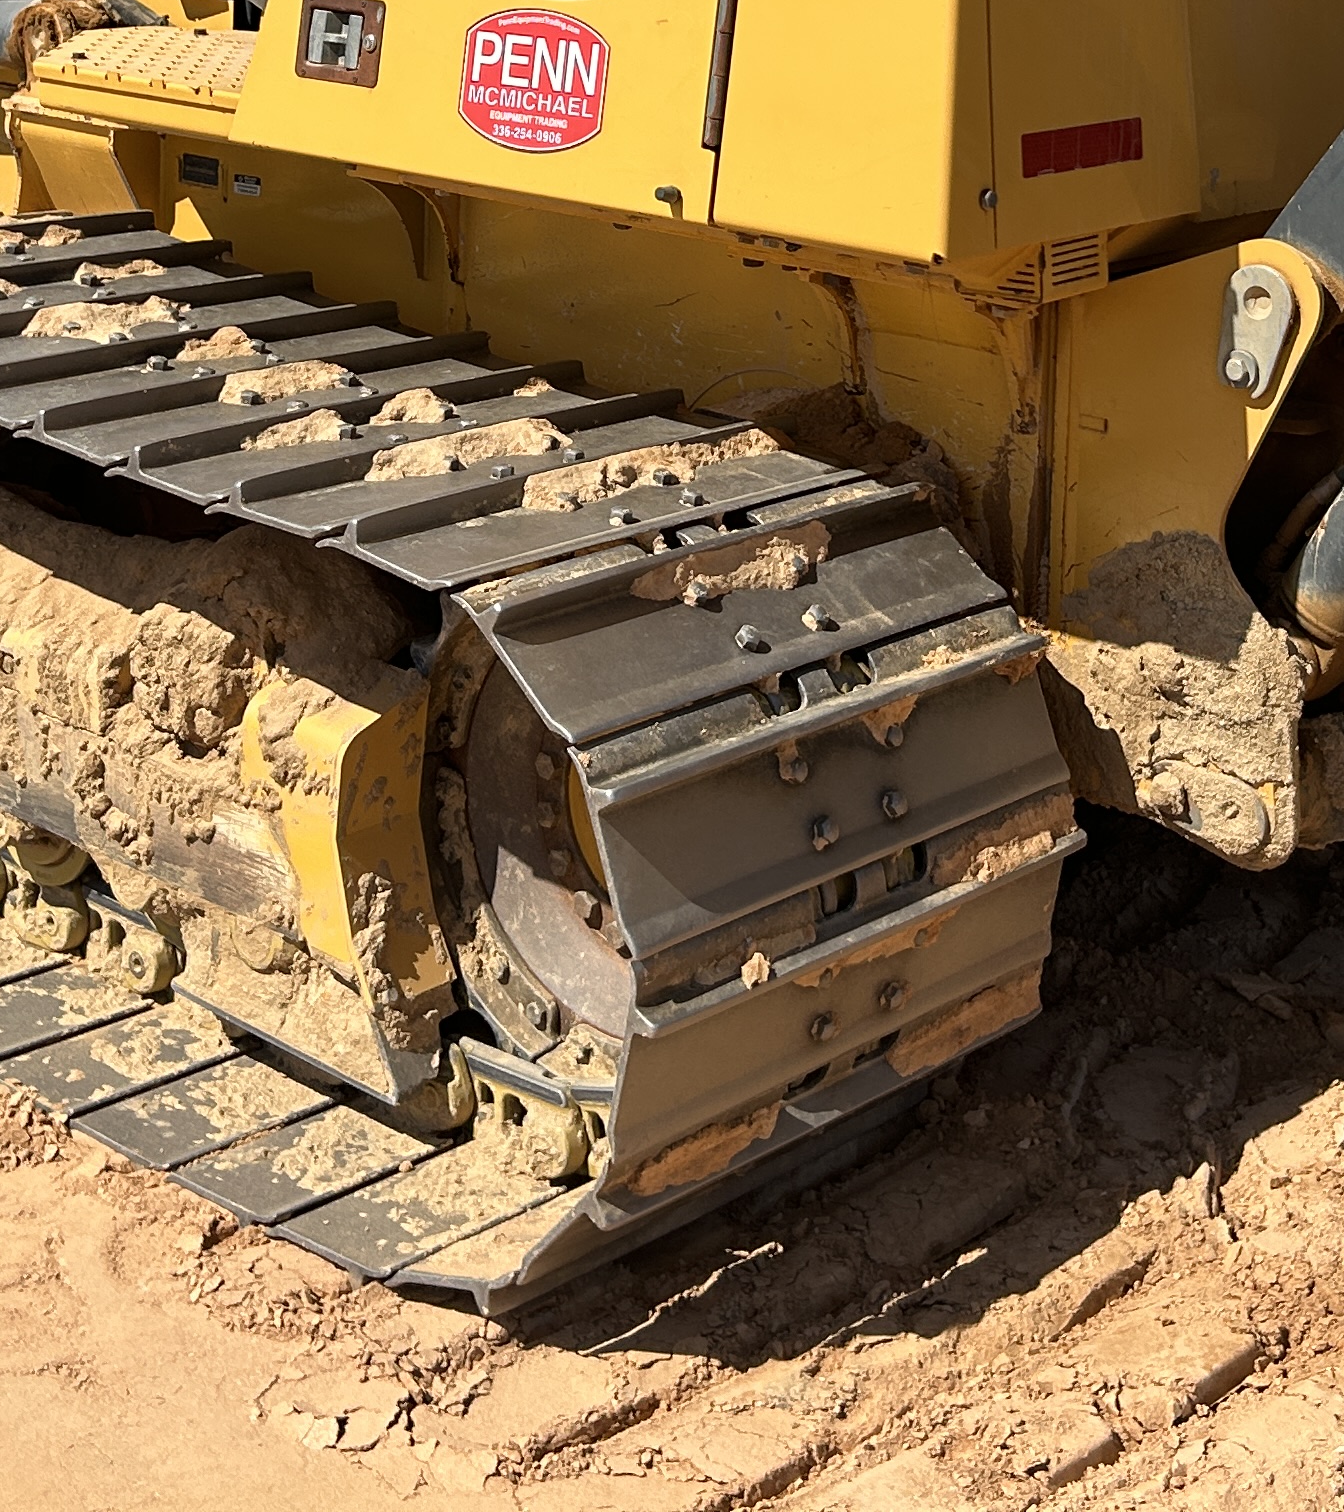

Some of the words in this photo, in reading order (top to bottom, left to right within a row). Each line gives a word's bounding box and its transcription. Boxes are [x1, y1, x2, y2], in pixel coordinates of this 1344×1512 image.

[470, 29, 601, 97] PENN
[467, 84, 594, 118] MCMICHAEL
[489, 109, 533, 124] EQUIPMENT
[534, 115, 568, 129] TRADING
